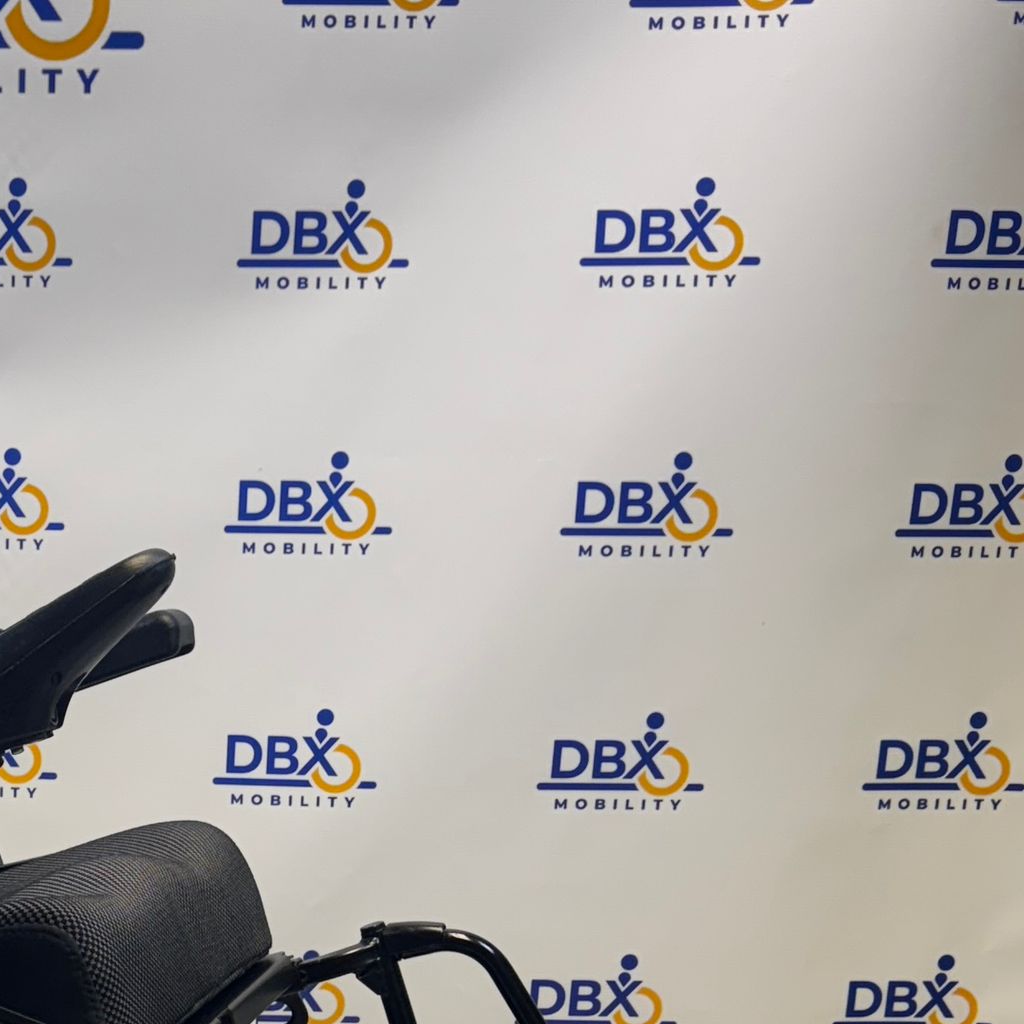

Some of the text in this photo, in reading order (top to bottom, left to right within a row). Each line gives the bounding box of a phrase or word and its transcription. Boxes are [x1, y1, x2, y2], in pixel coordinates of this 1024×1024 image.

[302, 15, 435, 29] MOBILITY
[649, 14, 789, 30] MOBILITY
[251, 211, 370, 255] DBX
[595, 208, 721, 253] DBX
[946, 210, 1024, 255] DB
[255, 277, 385, 289] MOBILITY
[599, 275, 736, 288] MOBILITY
[948, 277, 1024, 290] MOBIL
[238, 480, 354, 522] DBX
[575, 482, 697, 524] DBX
[909, 484, 1024, 525] DBX
[243, 542, 369, 555] MOBILITY
[579, 545, 709, 557] MOBILITY
[911, 546, 1018, 558] MOBILIT
[226, 735, 339, 776] DBX
[551, 740, 668, 779] DBX
[876, 740, 990, 779] DBX
[231, 794, 354, 808] MOBILITY
[554, 799, 681, 810] MOBILITY
[878, 798, 1001, 810] MOBILITY
[531, 979, 644, 1017] DBX
[845, 981, 958, 1018] DBX
